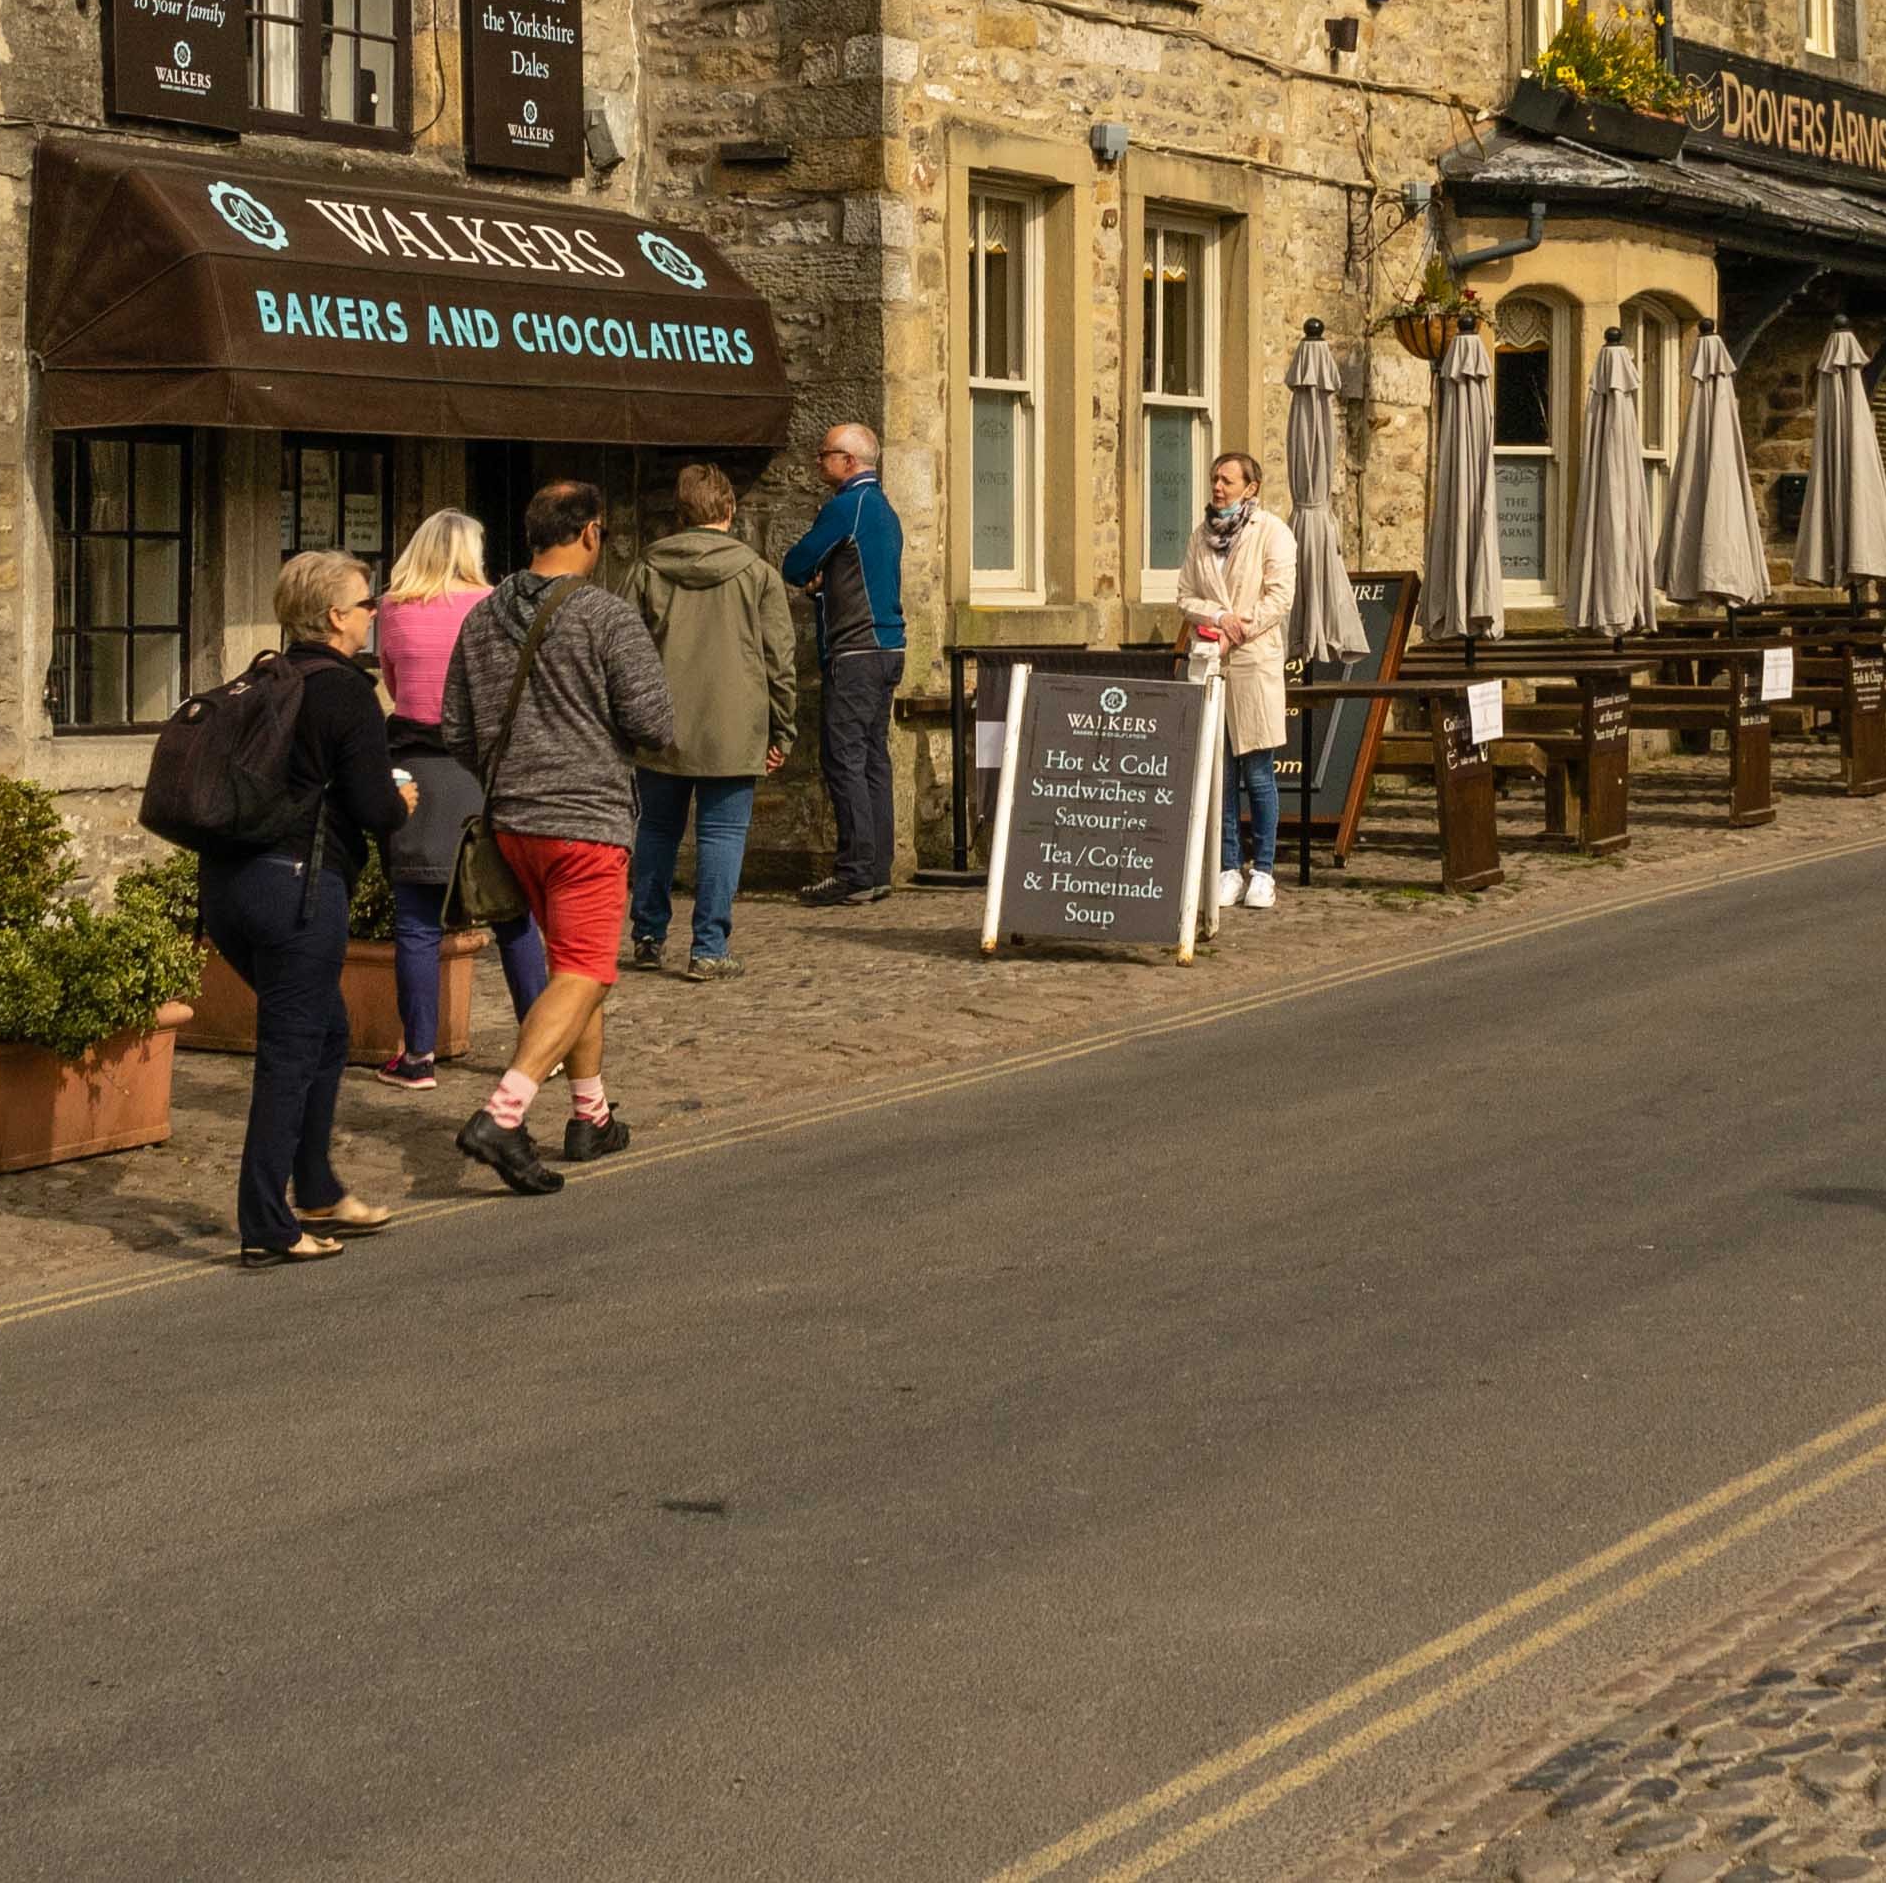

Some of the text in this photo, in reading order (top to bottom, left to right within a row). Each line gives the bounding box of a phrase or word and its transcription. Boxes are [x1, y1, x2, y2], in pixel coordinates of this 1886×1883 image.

[482, 5, 575, 44] the Yorkshire
[155, 66, 212, 90] WALKERS
[511, 51, 550, 79] Dales
[1694, 91, 1717, 122] THE
[1721, 70, 1827, 158] DROVERS
[507, 123, 554, 142] WALKERS
[305, 198, 625, 278] WALKERS
[256, 290, 755, 366] BAKERS AND CHOCOLATIERS
[1505, 497, 1529, 508] THE
[1501, 528, 1532, 537] ARMS
[1068, 712, 1157, 733] WALKERS
[1045, 750, 1168, 777] Hot & Cold
[1031, 778, 1174, 805] Sandwiches &
[1054, 807, 1147, 832] Savouries
[1023, 871, 1163, 899] & Homemade
[1064, 902, 1115, 931] Soup
